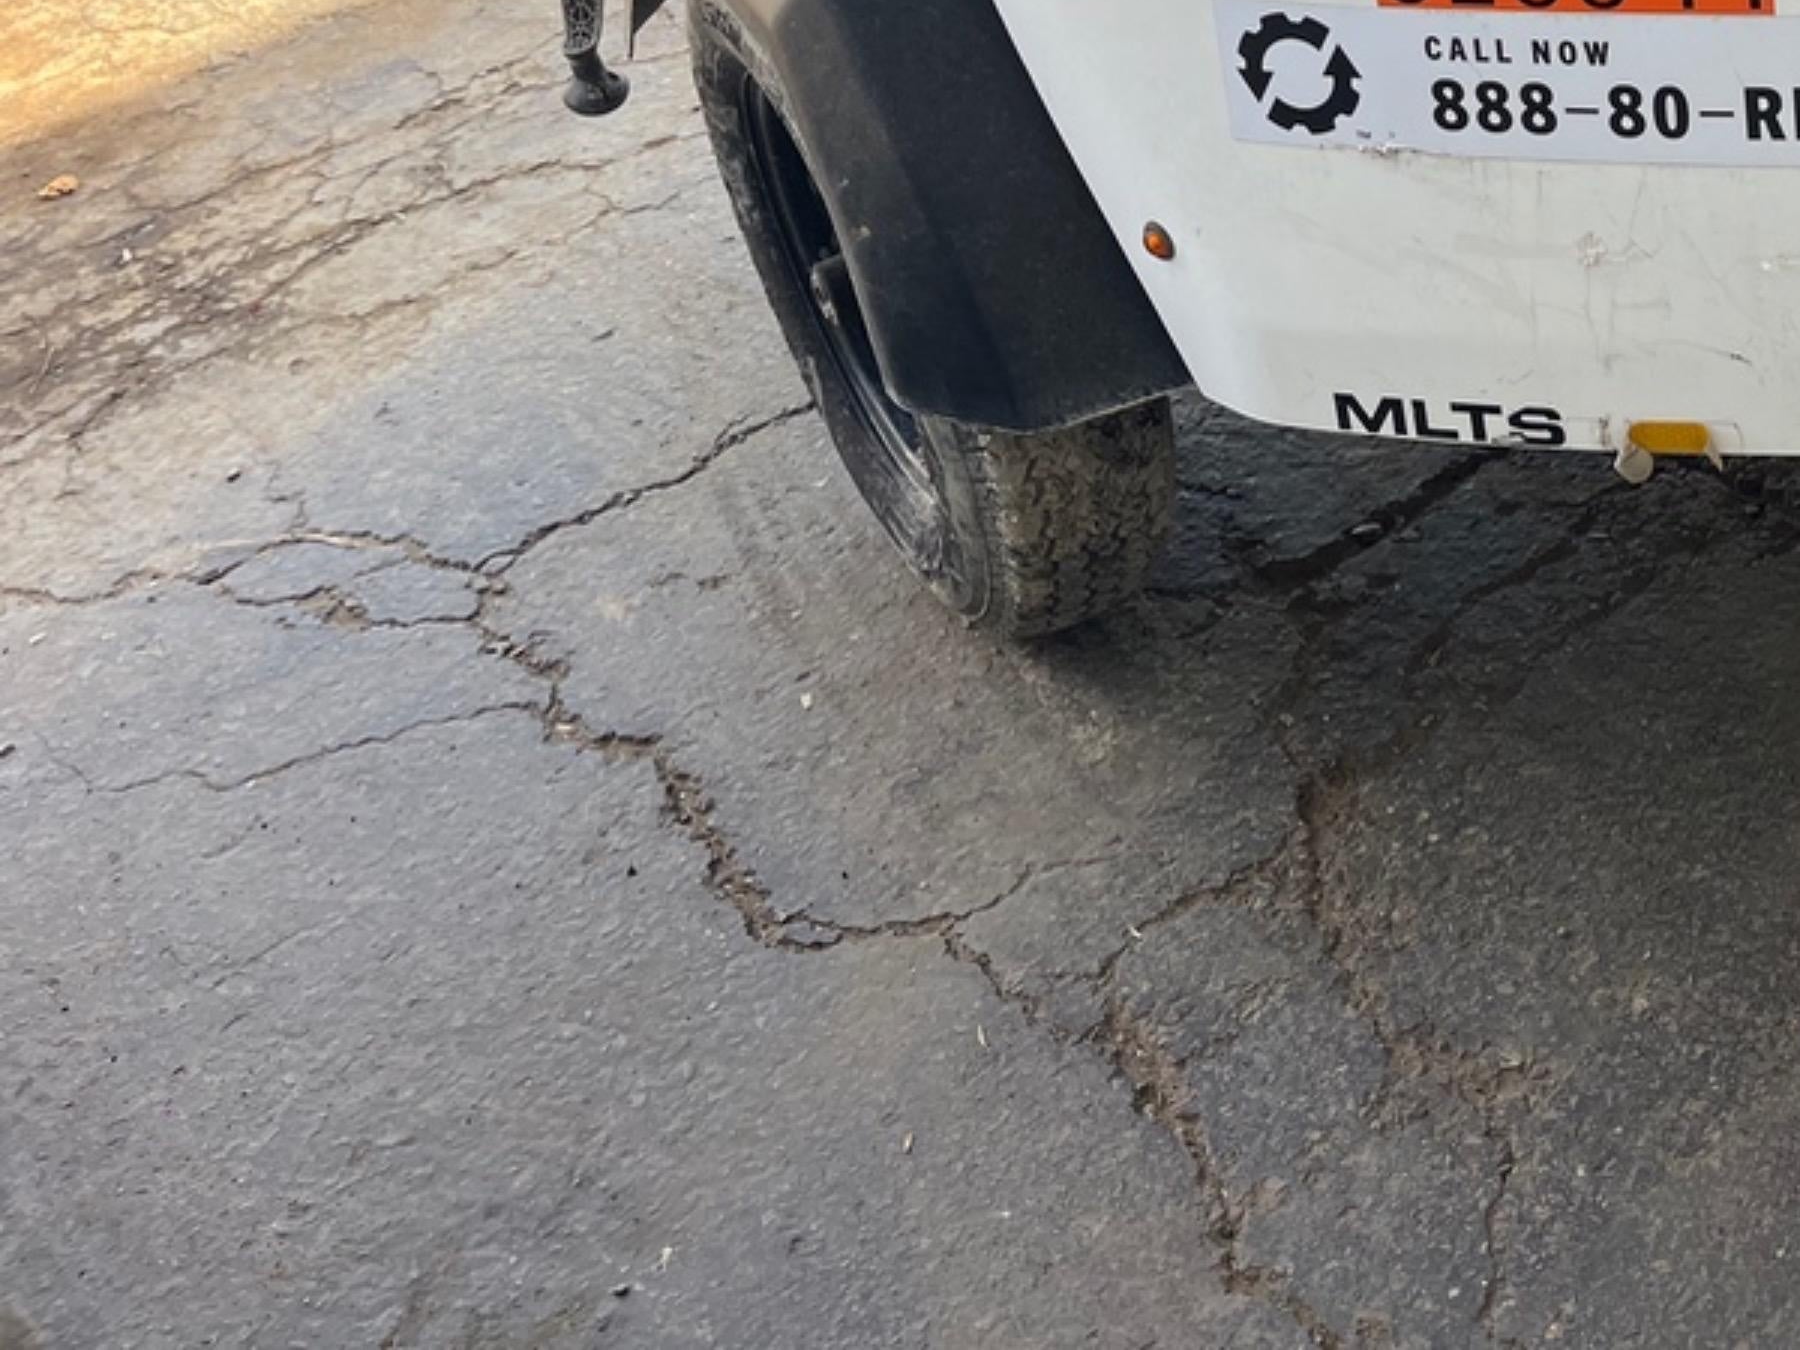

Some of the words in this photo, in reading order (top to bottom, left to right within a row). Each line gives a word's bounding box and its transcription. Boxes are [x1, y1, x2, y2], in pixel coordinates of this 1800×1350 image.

[1424, 35, 1513, 64] CALL
[1531, 39, 1610, 68] NOW
[1333, 392, 1566, 446] MLTS
